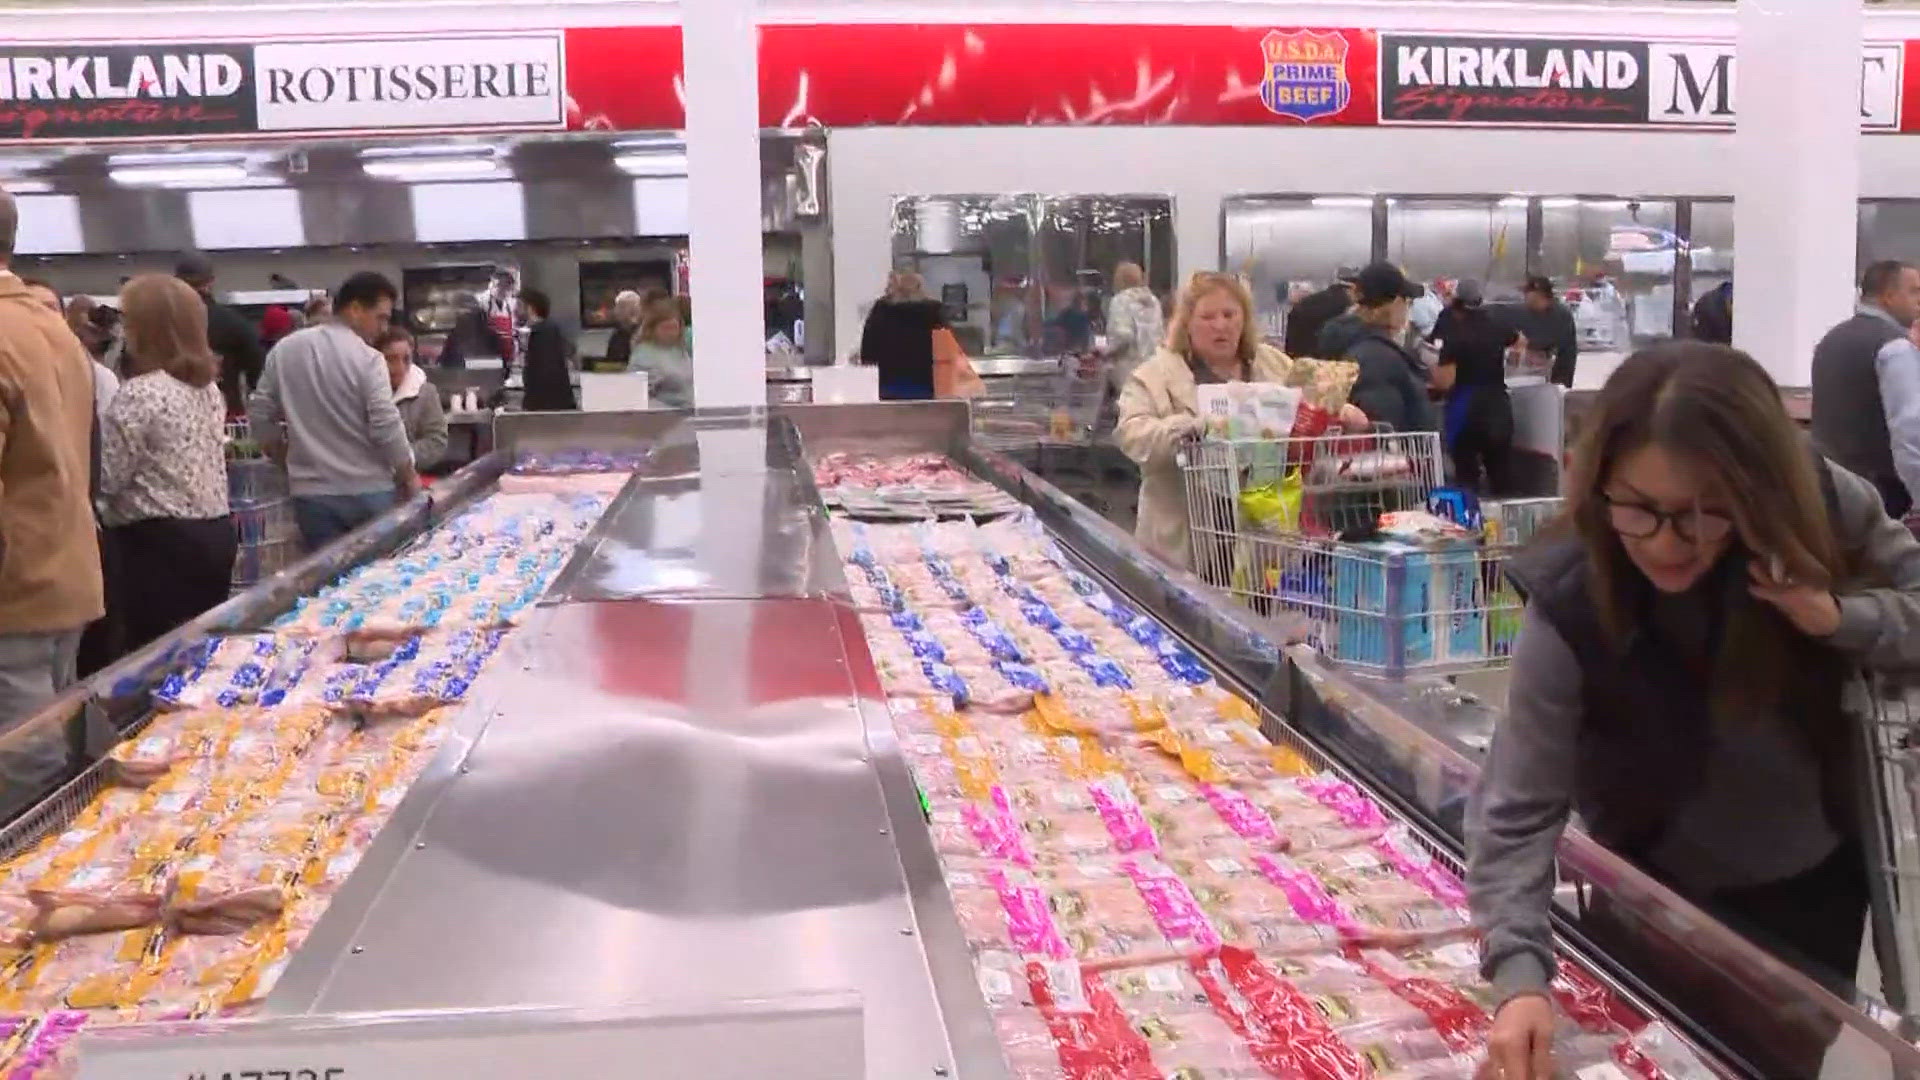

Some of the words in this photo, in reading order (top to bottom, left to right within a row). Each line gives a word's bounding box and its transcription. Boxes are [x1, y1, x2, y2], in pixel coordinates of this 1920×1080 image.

[0, 54, 242, 99] IRKLAND
[268, 62, 550, 104] ROTISSERIE
[1273, 65, 1337, 80] PRIME
[1398, 46, 1639, 89] KIRKLAND
[1278, 86, 1333, 105] BEEF
